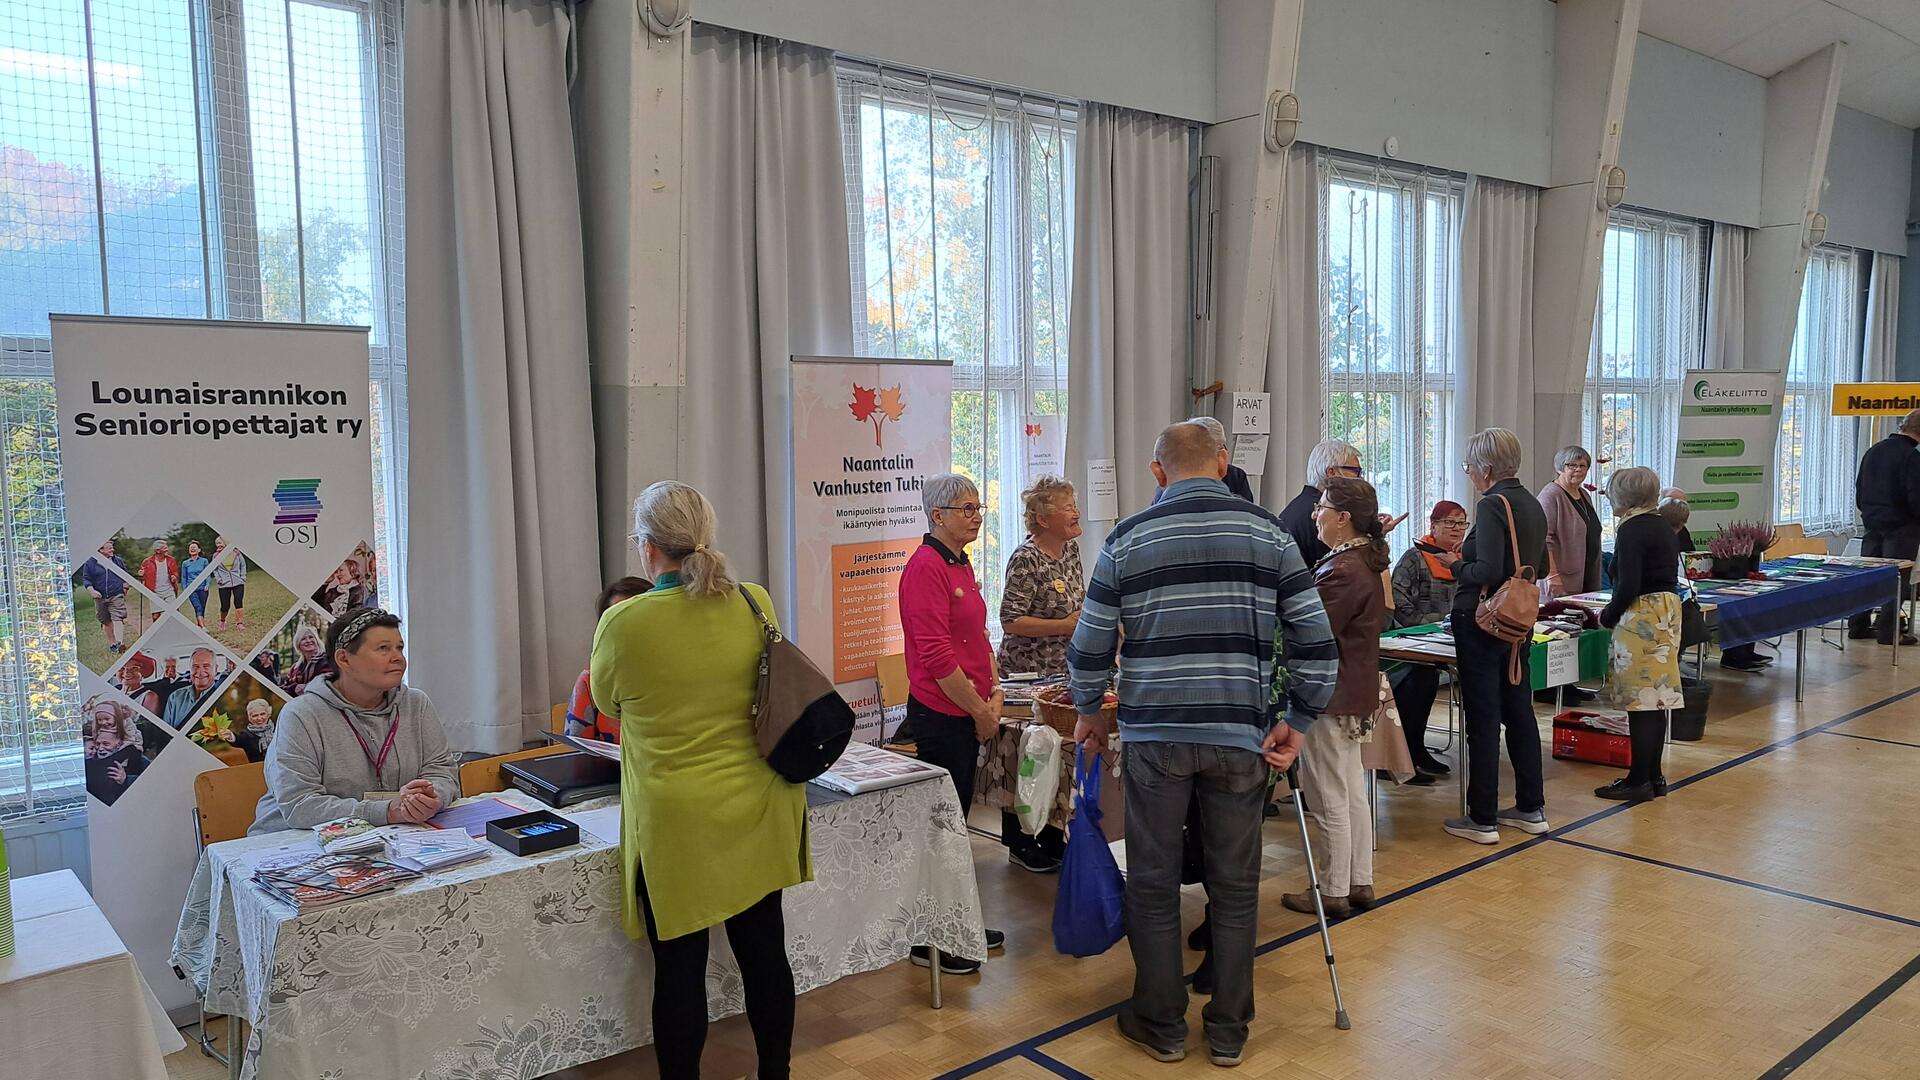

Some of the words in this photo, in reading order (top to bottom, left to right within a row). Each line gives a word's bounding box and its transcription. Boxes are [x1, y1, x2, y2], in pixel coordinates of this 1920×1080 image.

[91, 381, 347, 406] Lounaisrannikon
[1701, 388, 1768, 398] ELÄKELIITTO
[1236, 398, 1263, 410] ARVAT
[74, 412, 328, 439] Senioriopettajat
[336, 418, 363, 439] ry
[1244, 415, 1250, 427] 3
[1251, 415, 1257, 427] €
[842, 454, 914, 473] Naantalin
[813, 480, 892, 498] Vanhusten
[895, 475, 924, 493] Tuki
[836, 506, 885, 519] Monipuolista
[887, 504, 923, 514] toimintaa
[843, 519, 887, 530] ikääntyvien
[889, 517, 916, 528] hyväksi
[275, 525, 319, 549] OSJ
